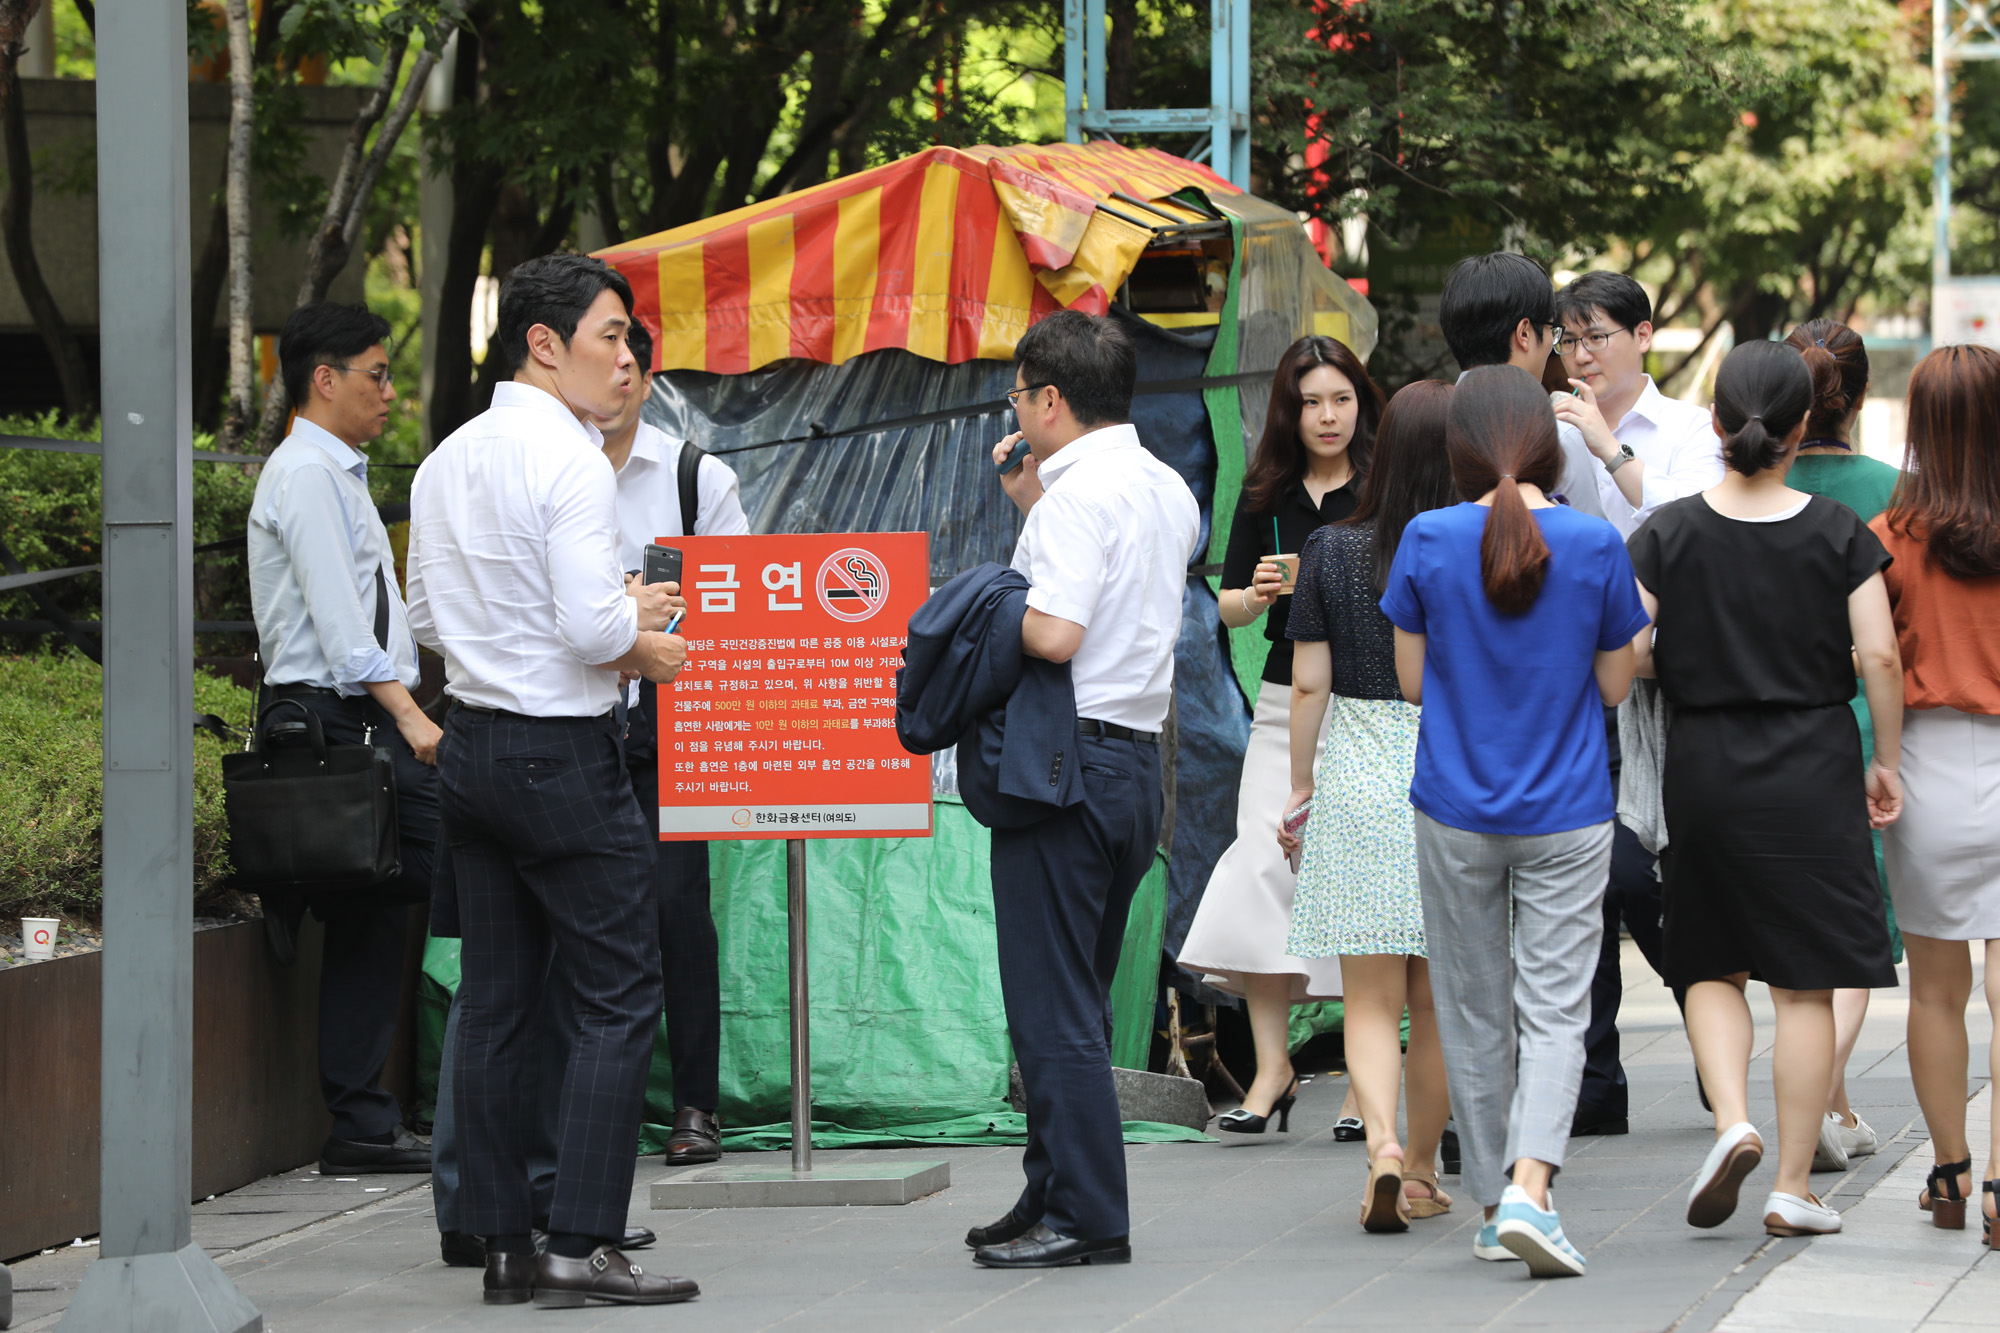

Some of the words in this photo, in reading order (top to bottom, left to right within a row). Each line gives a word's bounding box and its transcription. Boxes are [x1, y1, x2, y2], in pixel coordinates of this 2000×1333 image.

[686, 639, 715, 651] 빌딩은
[719, 638, 795, 650] 국민건강증진법에
[800, 638, 819, 649] 따른
[823, 638, 842, 649] 공중
[847, 637, 865, 648] 이용
[698, 659, 727, 671] 구역을
[732, 659, 761, 670] 시설의
[767, 658, 825, 670] 출입구로부터
[831, 658, 849, 668] 10M
[855, 657, 874, 668] 이상
[674, 680, 713, 692] 설치토록
[719, 680, 758, 691] 규정하고
[765, 679, 797, 690] 있으며,
[804, 679, 812, 689] 위
[818, 678, 847, 689] 사항을
[854, 677, 883, 688] 위반할
[674, 701, 711, 712] 건물주에
[715, 700, 741, 711] 500만
[746, 700, 755, 711] 원
[759, 700, 786, 710] 이하의
[791, 699, 818, 710] 과태료
[823, 698, 844, 709] 부과,
[848, 698, 867, 709] 금연
[674, 721, 702, 732] 흡연한
[705, 720, 751, 732] 사람에게는
[755, 720, 774, 731] 10만
[778, 720, 787, 730] 원
[791, 719, 818, 730] 이하의
[823, 718, 859, 729] 과태료를
[674, 742, 684, 752] 이
[689, 741, 708, 752] 점을
[714, 741, 743, 751] 유념해
[748, 740, 778, 751] 주시기
[783, 739, 825, 750] 바랍니다.
[674, 762, 694, 772] 또한
[699, 761, 728, 772] 흡연은
[734, 761, 758, 772] 1층에
[763, 760, 792, 771] 마련된
[797, 760, 816, 771] 외부
[822, 759, 841, 770] 흡연
[846, 759, 875, 770] 공간을
[881, 758, 910, 769] 이용해
[675, 782, 704, 793] 주시기
[710, 781, 752, 792] 바랍니다.
